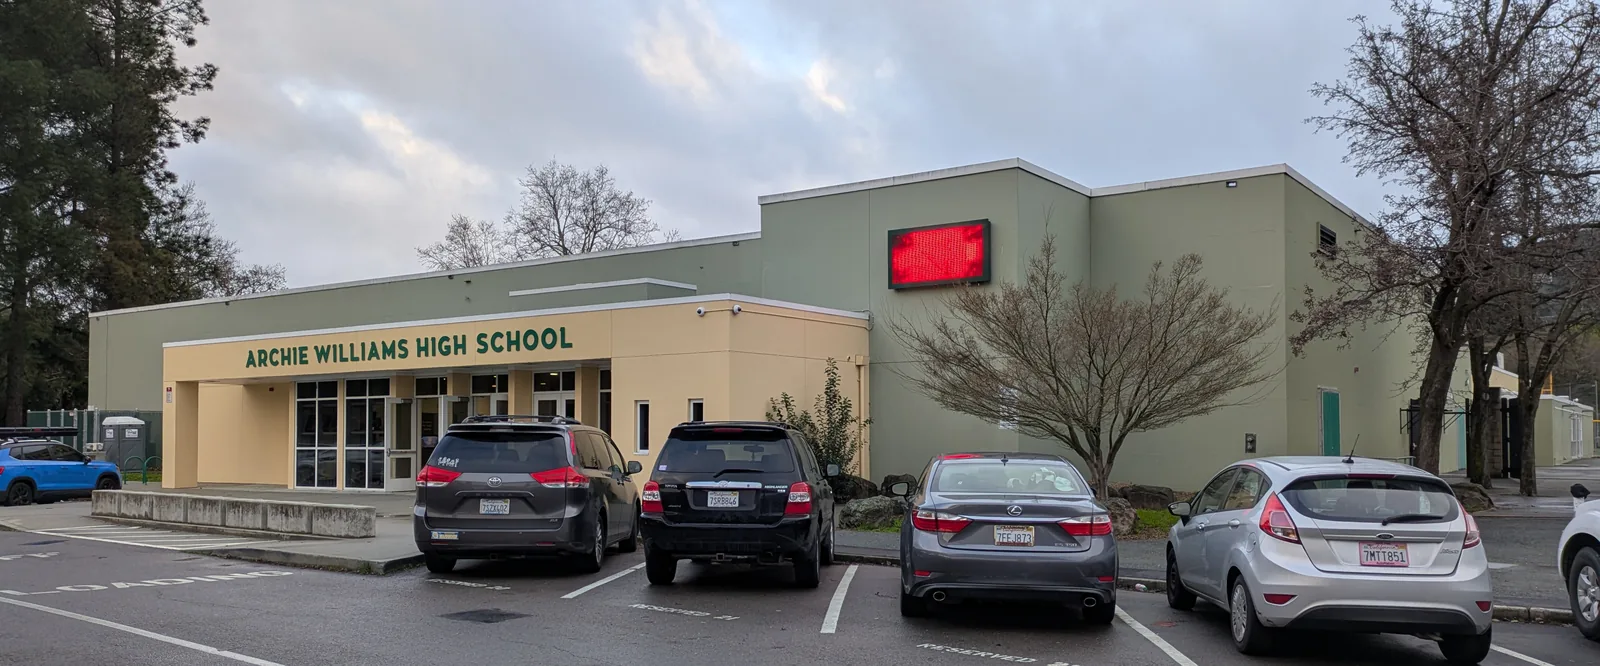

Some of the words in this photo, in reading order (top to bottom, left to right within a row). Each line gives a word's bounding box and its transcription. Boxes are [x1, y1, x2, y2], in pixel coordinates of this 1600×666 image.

[245, 345, 309, 369] ARCHIE
[313, 338, 409, 364] WILLIAMS
[415, 334, 467, 358] HIGH
[476, 326, 573, 354] SCHOOL
[997, 532, 1032, 543] 7FEJ873
[1363, 550, 1406, 563] 7MTT851
[0, 570, 294, 596] LOADING
[916, 643, 1037, 663] RESERVED
